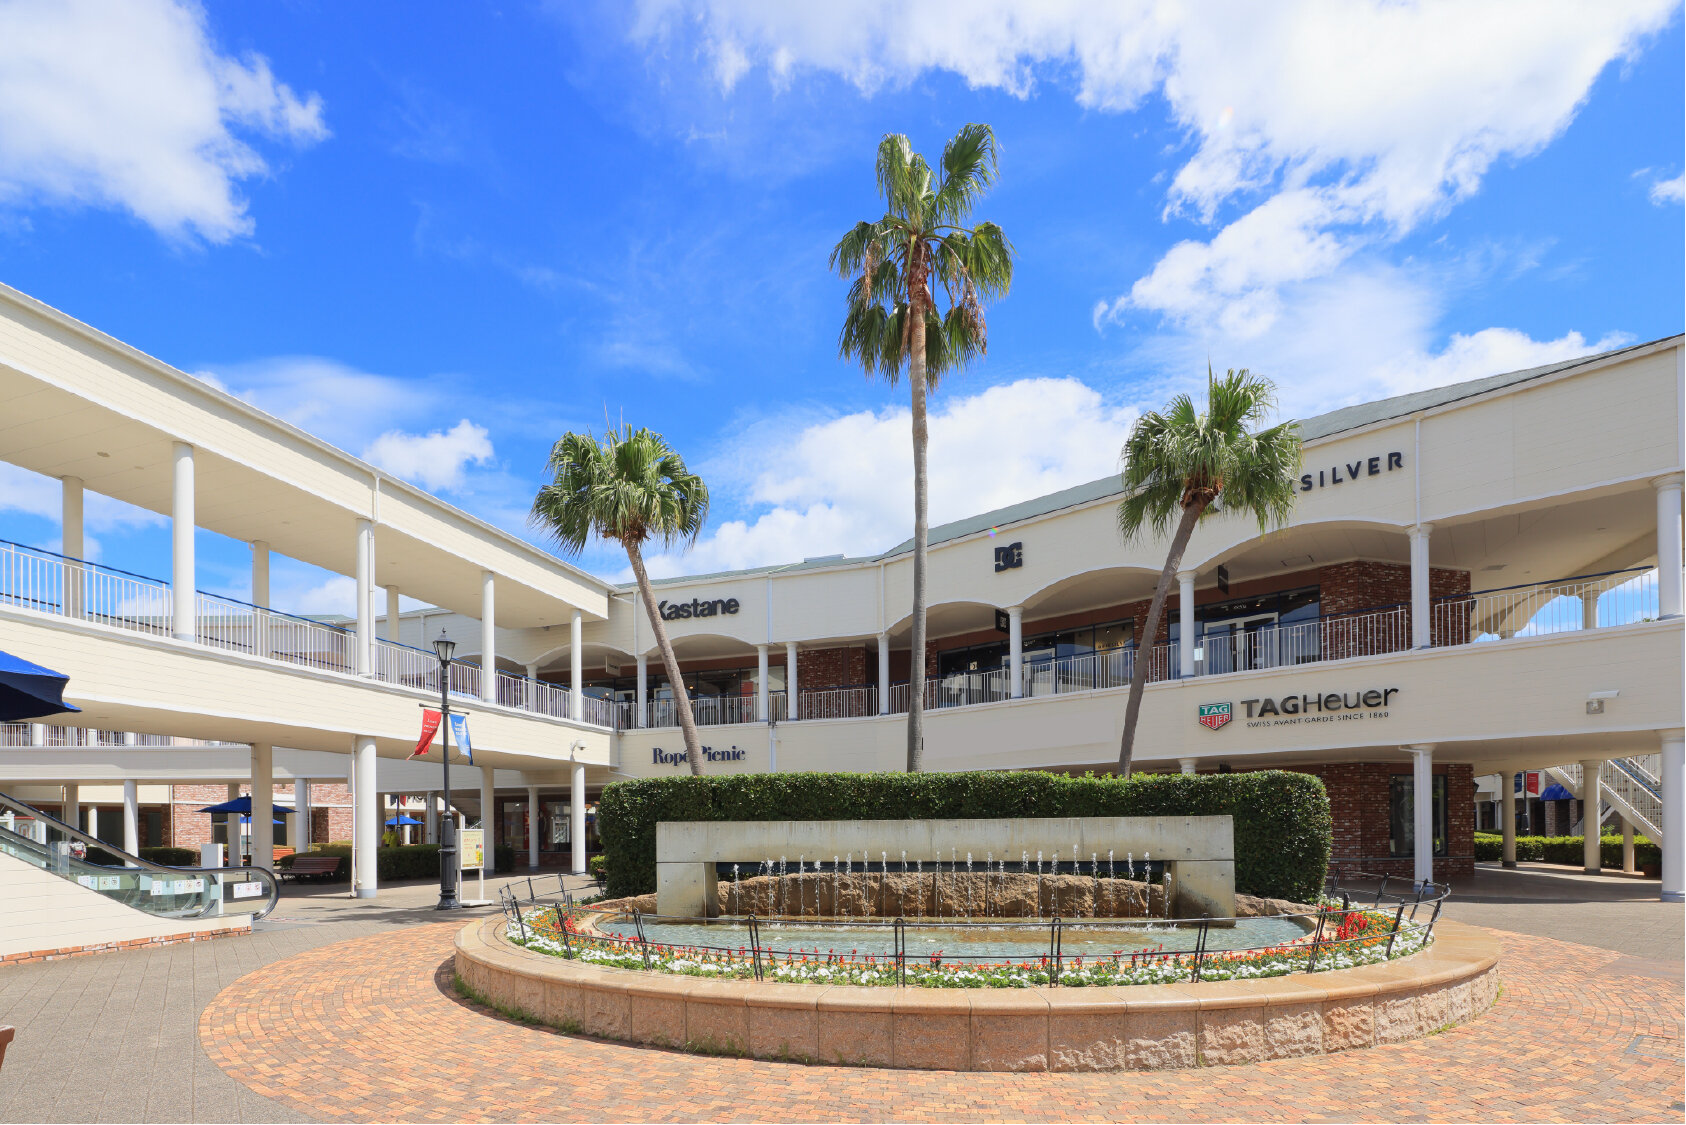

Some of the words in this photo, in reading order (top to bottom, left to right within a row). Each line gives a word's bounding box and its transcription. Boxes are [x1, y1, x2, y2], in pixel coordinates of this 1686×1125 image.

[1294, 452, 1403, 494] SILVER
[658, 598, 739, 621] Kastane
[1202, 705, 1228, 715] TAG
[1337, 713, 1364, 721] SINCE
[1369, 711, 1389, 719] 1860
[1201, 714, 1228, 729] HEUER
